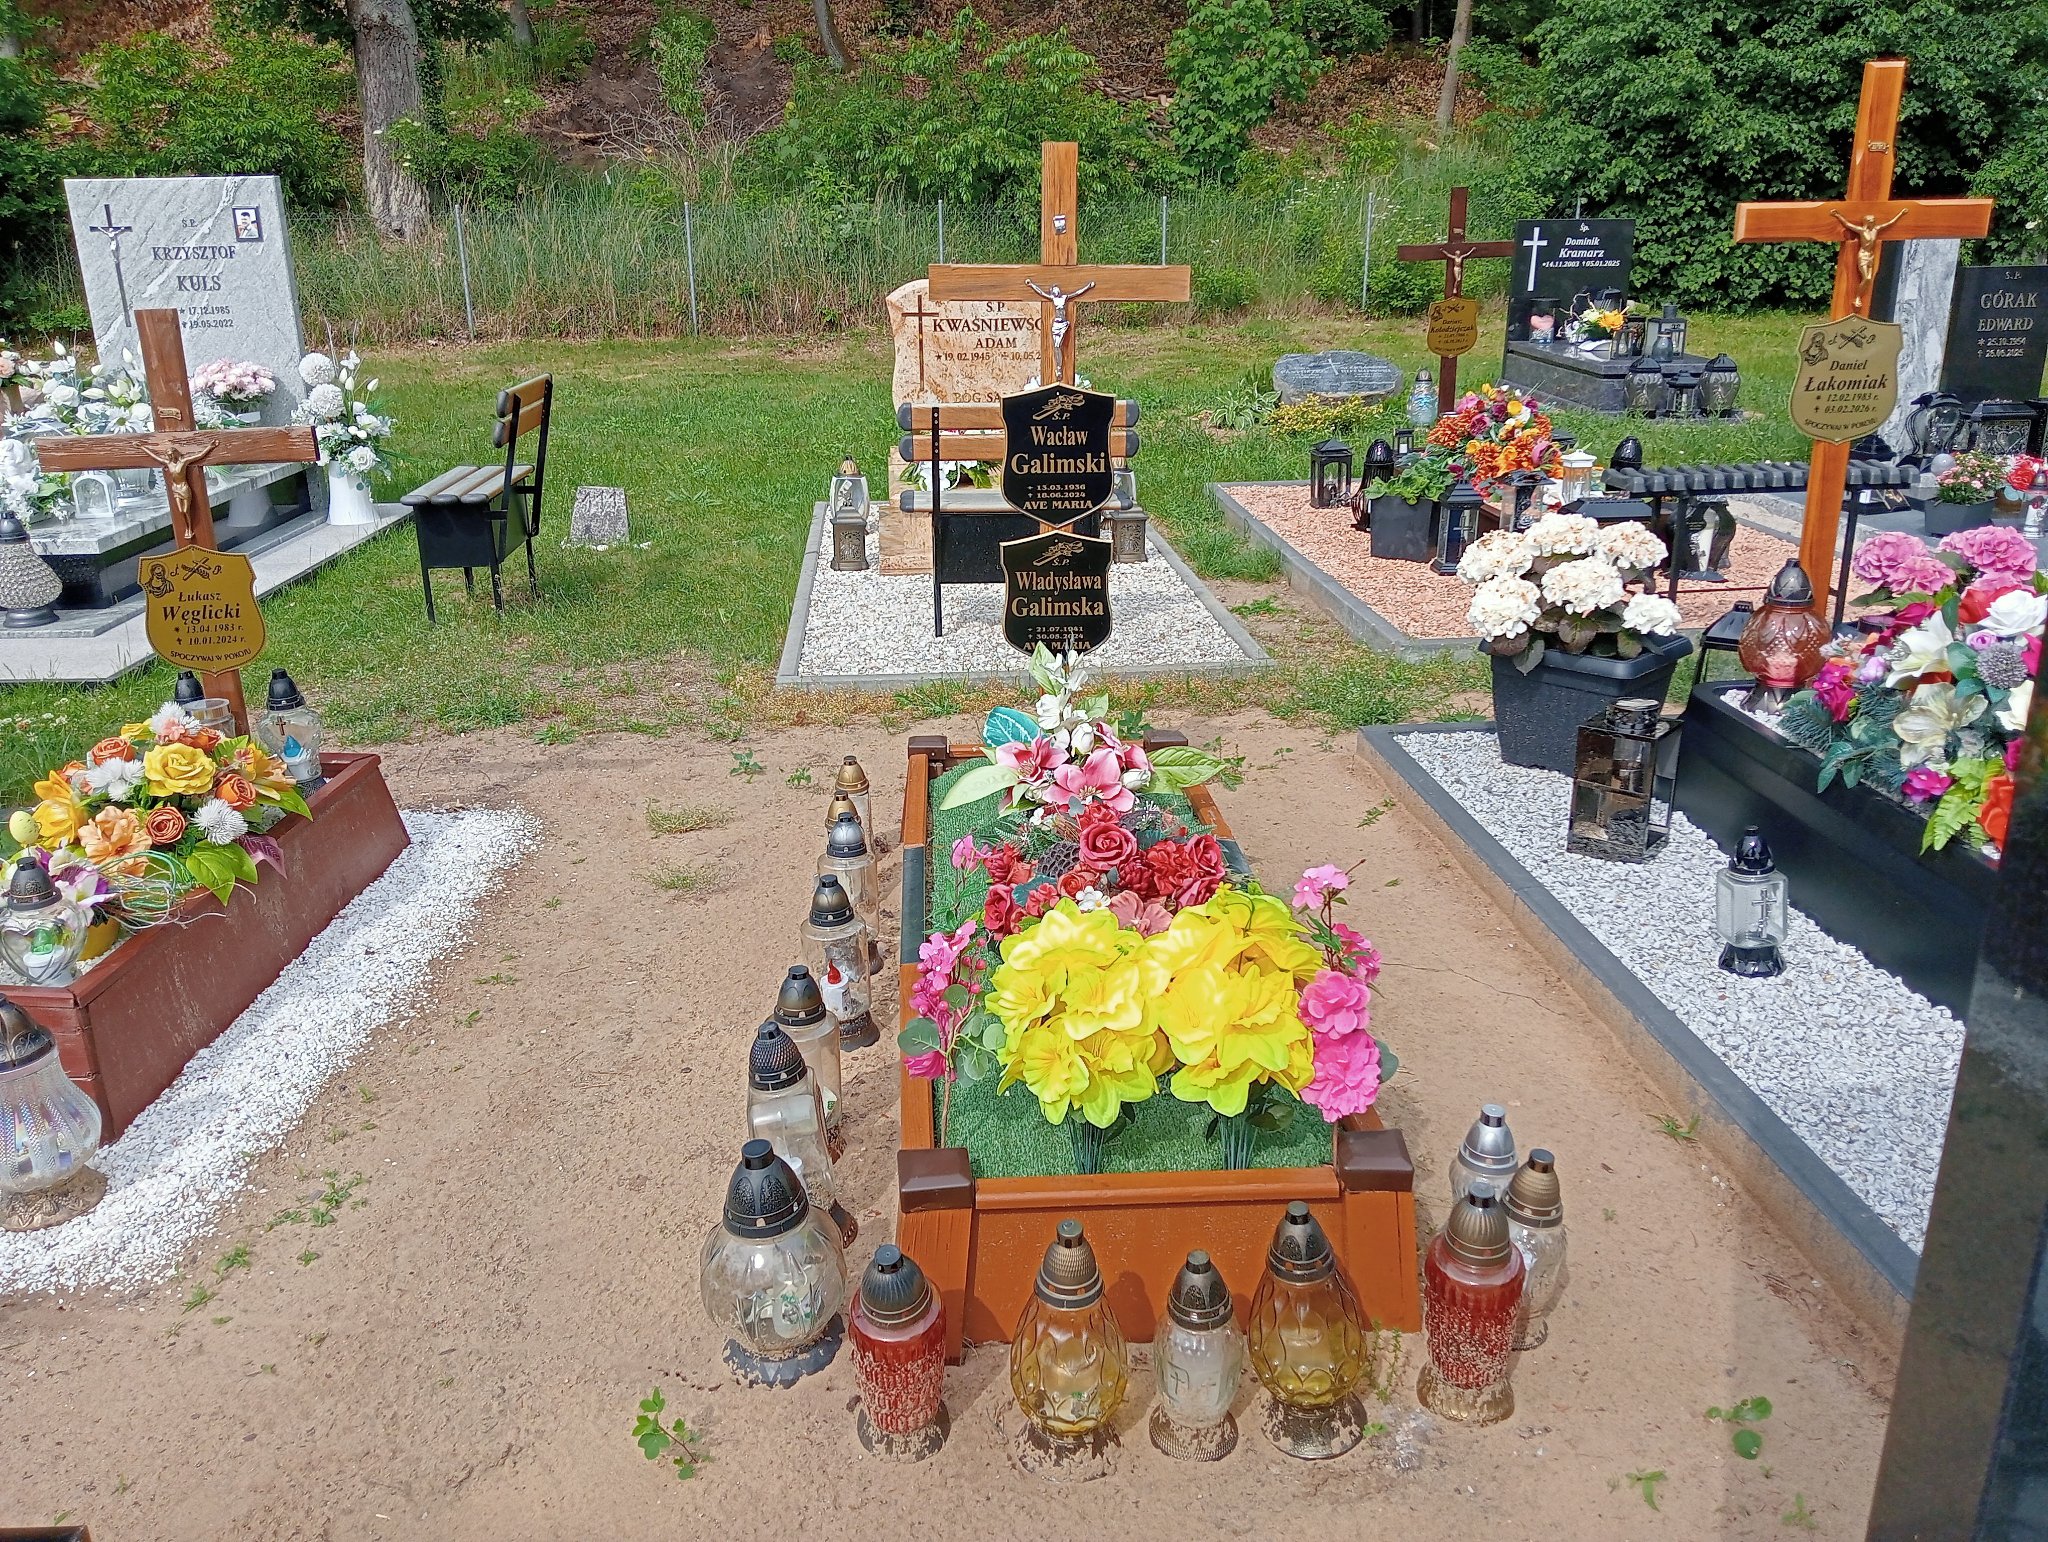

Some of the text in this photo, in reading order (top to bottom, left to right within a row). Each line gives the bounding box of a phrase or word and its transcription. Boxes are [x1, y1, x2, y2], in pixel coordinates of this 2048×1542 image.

[1565, 237, 1600, 246] Dominik
[152, 245, 236, 260] KRZYSZTOF
[1559, 248, 1605, 258] Kramarz
[176, 275, 221, 291] KULS
[1980, 289, 2038, 309] GÓRAK
[1977, 317, 2034, 332] EDWARD
[975, 337, 1018, 349] ADAM
[1829, 360, 1868, 371] Daniel
[1804, 374, 1888, 392] Łakomiak
[1030, 425, 1088, 446] Wacław
[1010, 452, 1106, 475] Galimski
[1023, 500, 1093, 510] AVE MARIA
[1015, 571, 1102, 595] Władysława
[178, 590, 222, 602] Łukasz
[162, 603, 241, 625] Węglicki
[1011, 596, 1105, 617] Galimska
